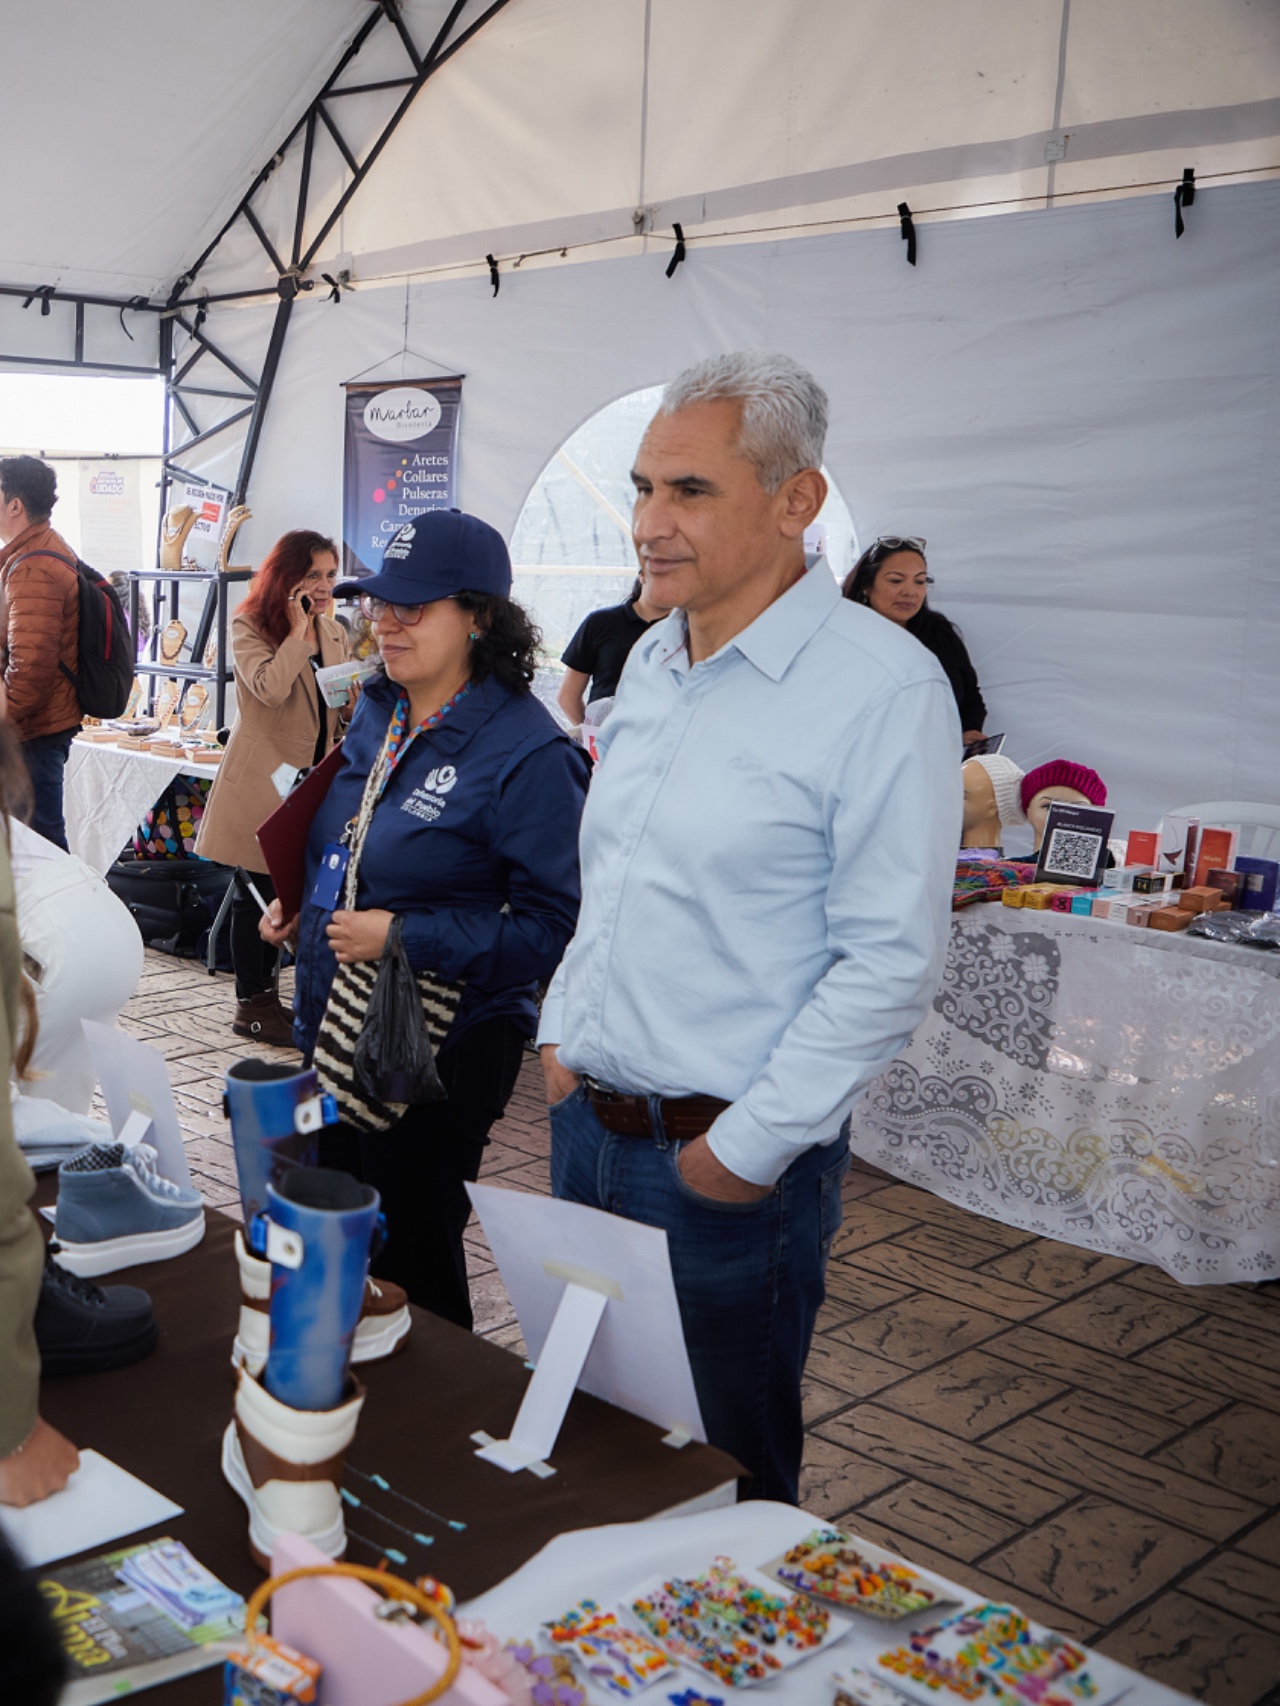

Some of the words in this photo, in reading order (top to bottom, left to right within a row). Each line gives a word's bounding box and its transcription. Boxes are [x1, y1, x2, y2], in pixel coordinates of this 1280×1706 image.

[412, 454, 449, 466] Aretes
[402, 470, 449, 483] Collares
[402, 486, 449, 499] Pulseras
